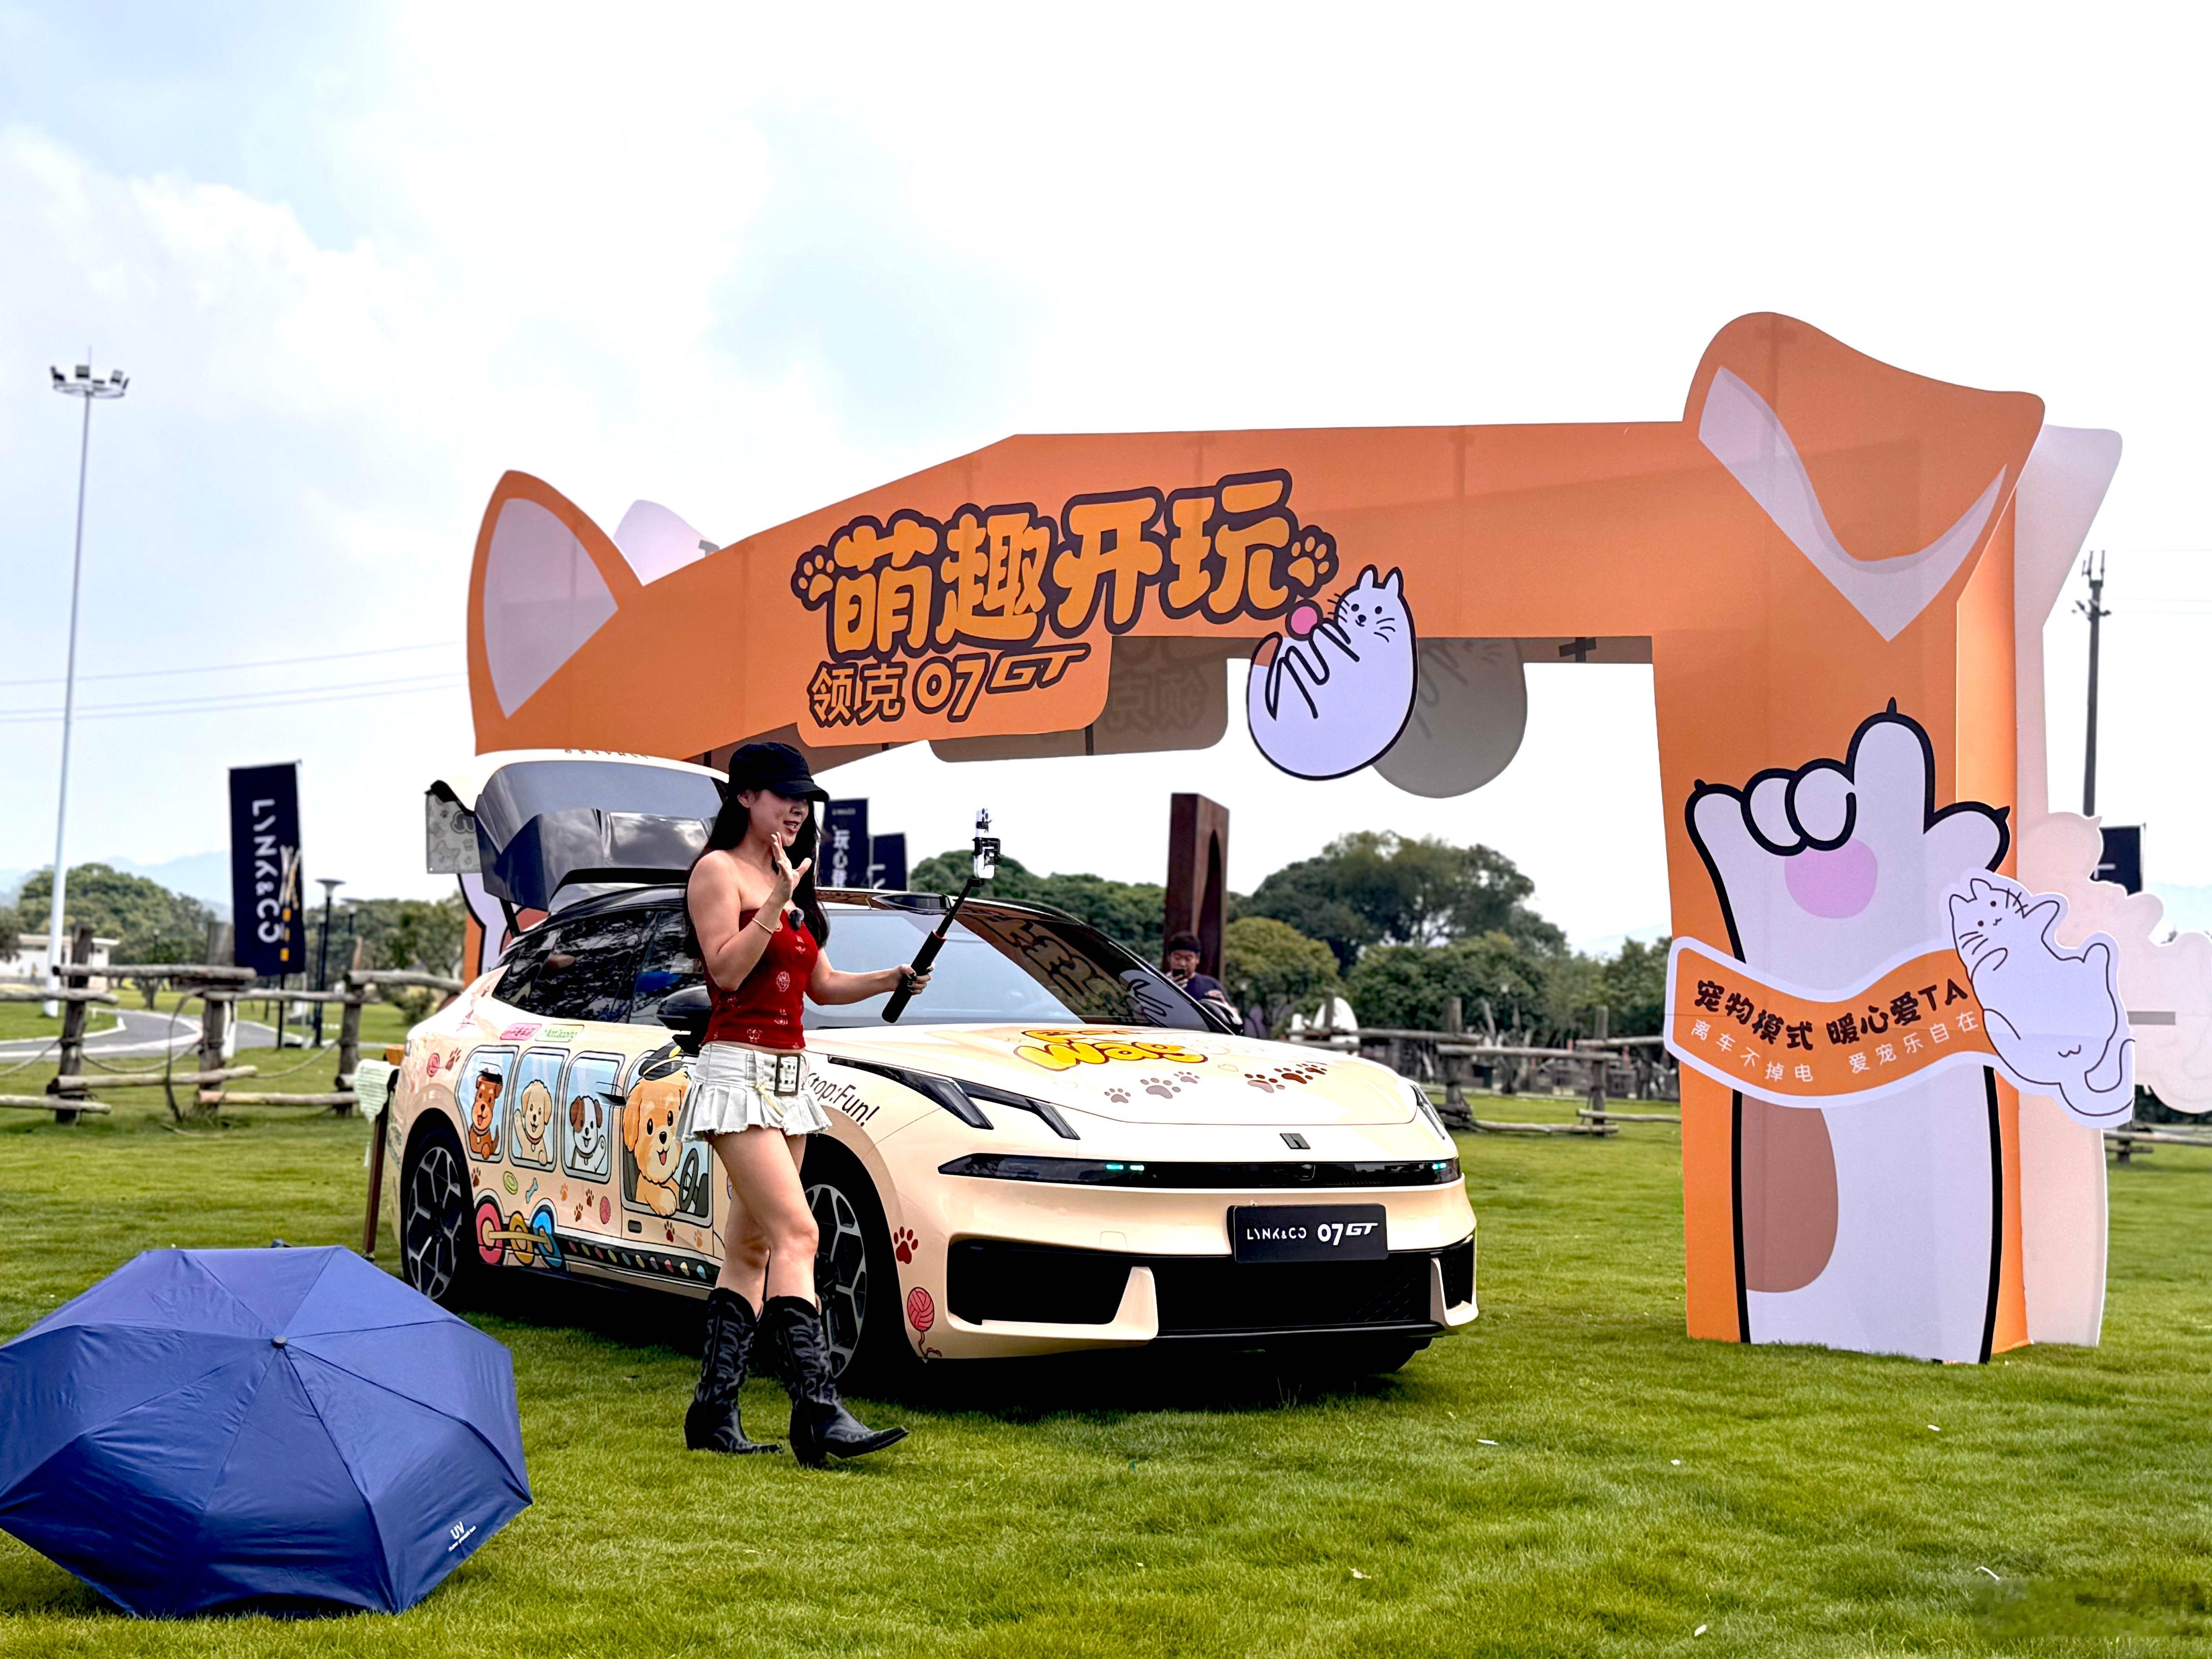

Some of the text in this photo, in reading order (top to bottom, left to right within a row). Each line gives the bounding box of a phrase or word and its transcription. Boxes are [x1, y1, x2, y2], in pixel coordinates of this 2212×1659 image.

[826, 468, 1293, 663] 萌趣开玩
[807, 661, 907, 728] 领克
[1691, 1011, 1979, 1082] 离车不掉电 爱宠乐自在
[1694, 978, 1968, 1051] 宠物模式 暖心爱TA
[450, 1521, 464, 1539] UV
